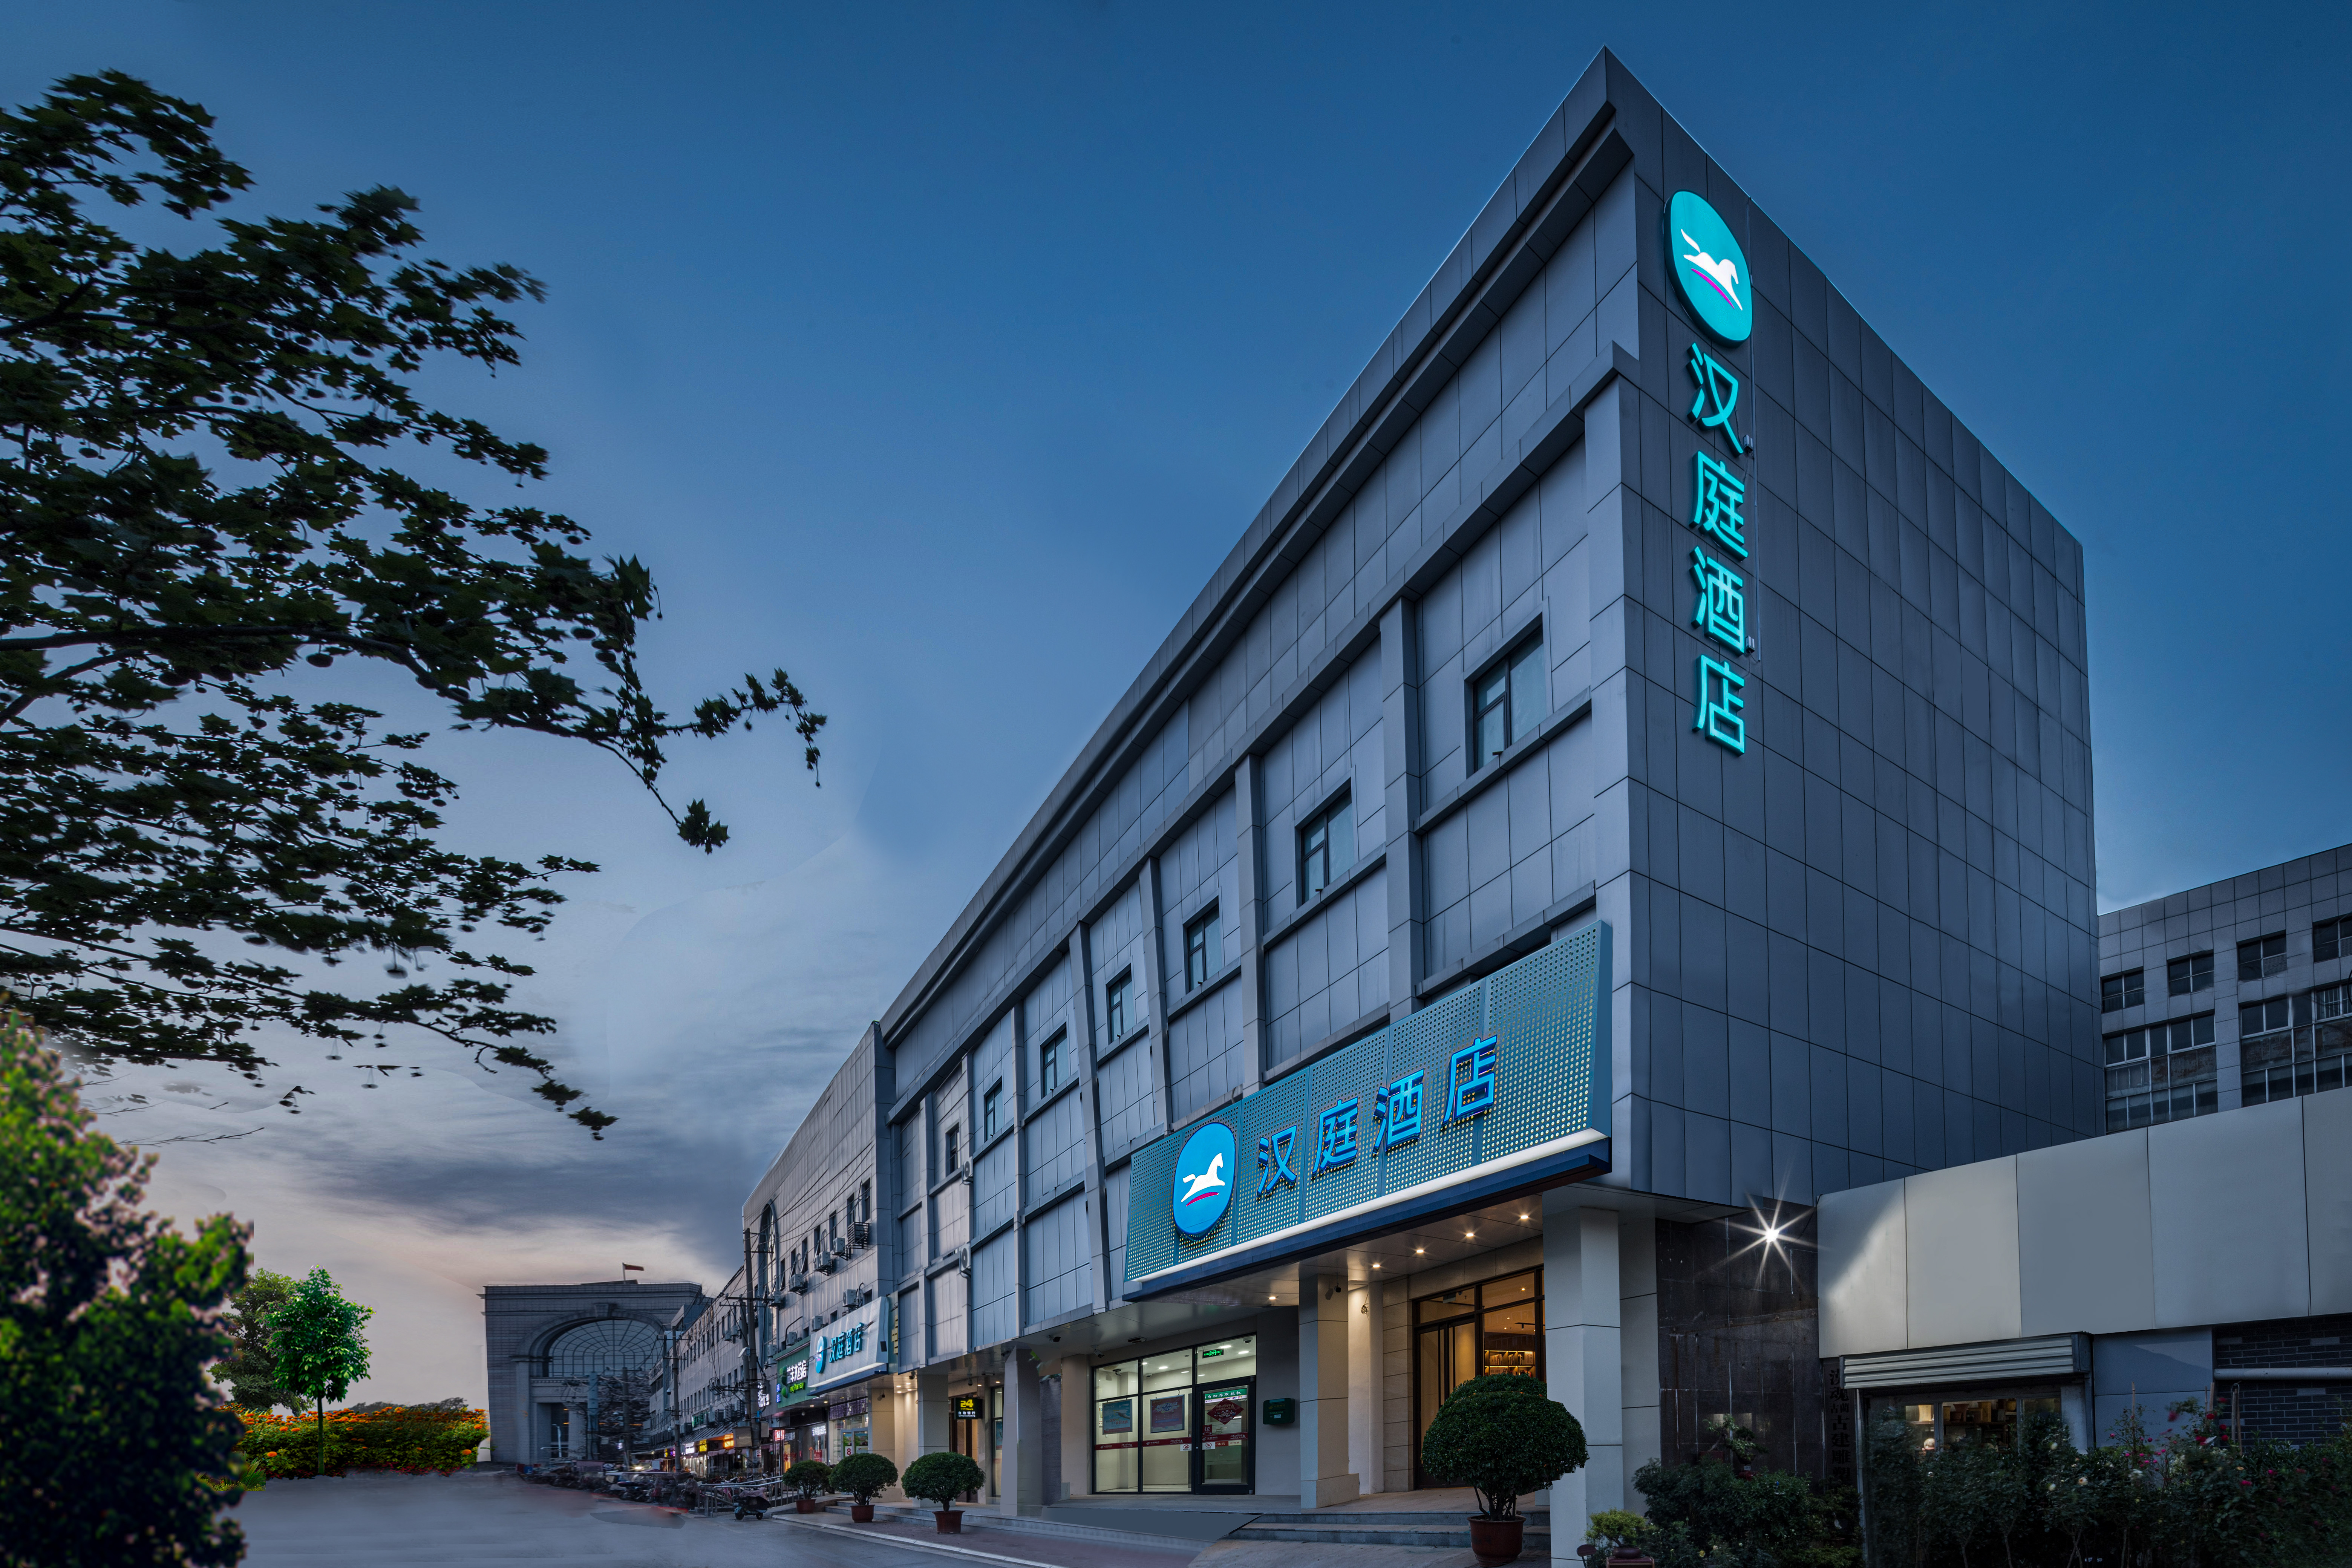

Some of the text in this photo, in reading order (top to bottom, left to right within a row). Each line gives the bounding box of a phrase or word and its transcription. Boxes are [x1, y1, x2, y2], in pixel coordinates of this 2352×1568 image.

[1686, 341, 1748, 755] 汉庭酒店
[1256, 1035, 1498, 1200] 汉庭酒店
[829, 1322, 864, 1363] 汉庭酒店
[960, 1399, 973, 1407] 24
